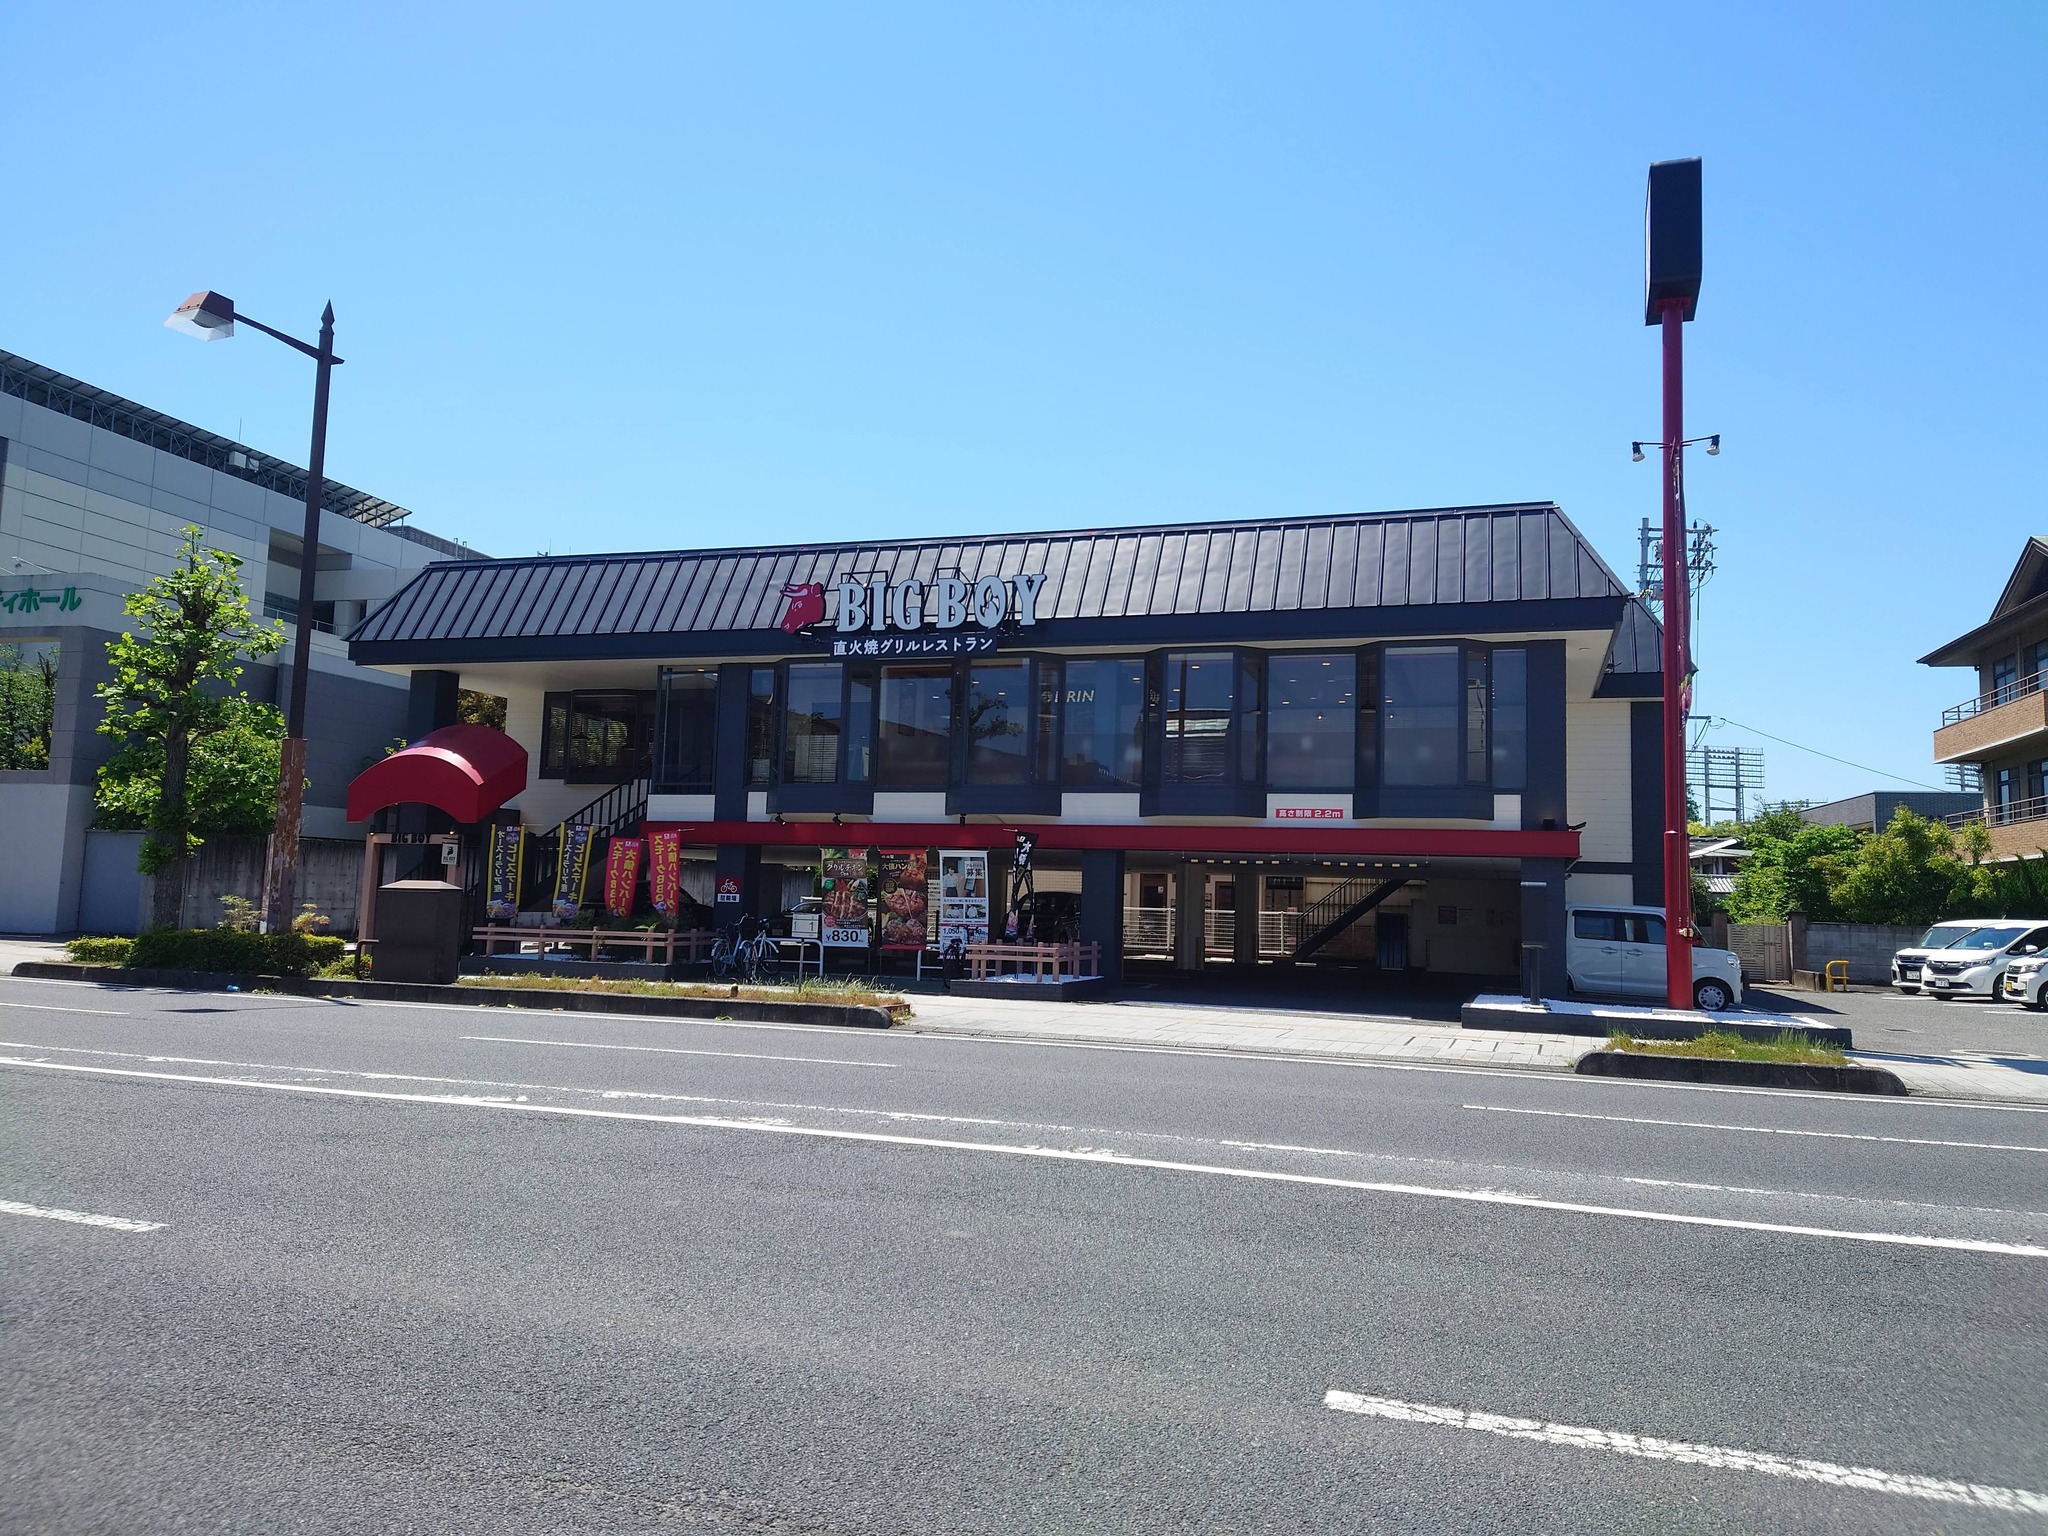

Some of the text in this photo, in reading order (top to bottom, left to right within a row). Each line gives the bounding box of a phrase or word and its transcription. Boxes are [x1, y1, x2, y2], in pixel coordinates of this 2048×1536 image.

[0, 586, 82, 614] ィホール
[836, 574, 1047, 632] BIG BOY
[832, 637, 994, 656] 直火焼グリルレストラン
[1278, 809, 1341, 818] 高さ制限 2.2m
[391, 832, 431, 844] BIG BOY
